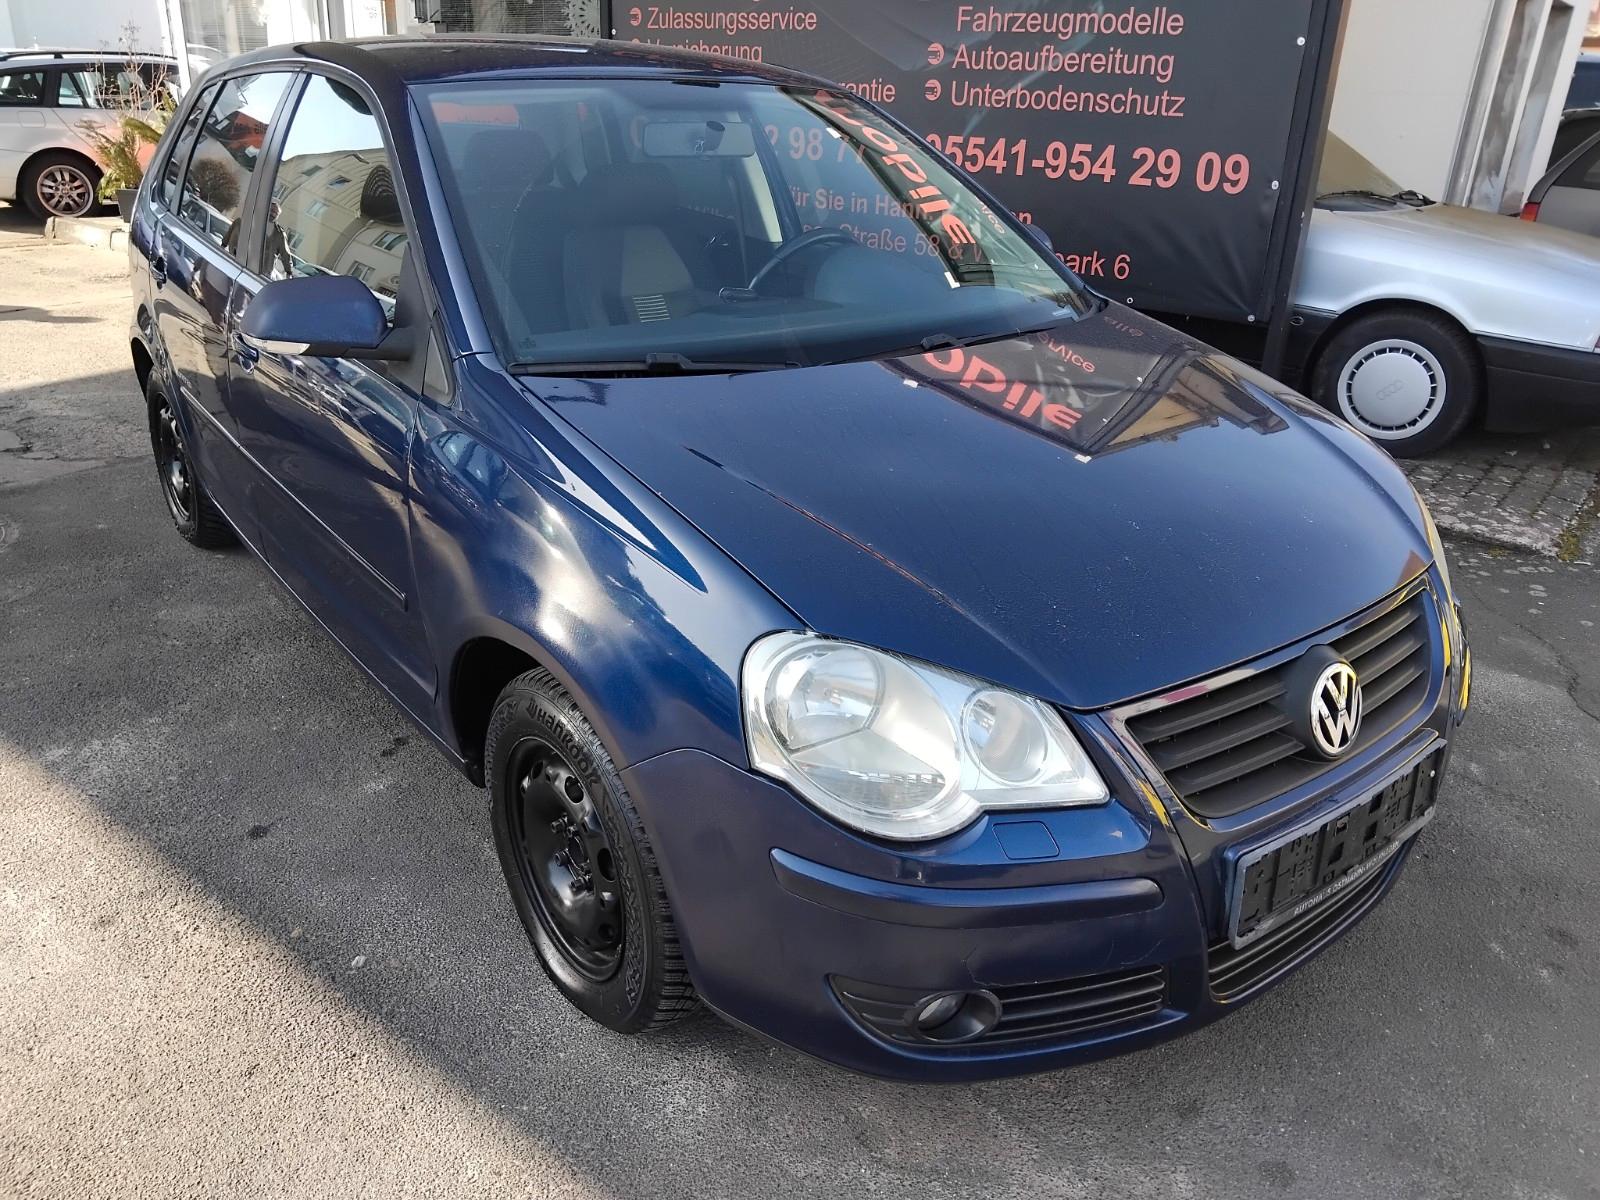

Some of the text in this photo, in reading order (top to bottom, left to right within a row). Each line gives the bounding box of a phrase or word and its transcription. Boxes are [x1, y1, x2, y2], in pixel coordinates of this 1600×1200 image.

[647, 7, 817, 35] Zulassungsservice
[955, 6, 1185, 40] Fahrzeugmodelle
[952, 44, 1175, 83] Autoaufbereitung
[951, 80, 1186, 118] Unterbodenschutz
[1127, 147, 1182, 188] 29
[1195, 151, 1250, 195] 09
[815, 189, 844, 211] Sie
[851, 192, 871, 215] in
[914, 233, 940, 257] 58
[1113, 254, 1131, 280] 6
